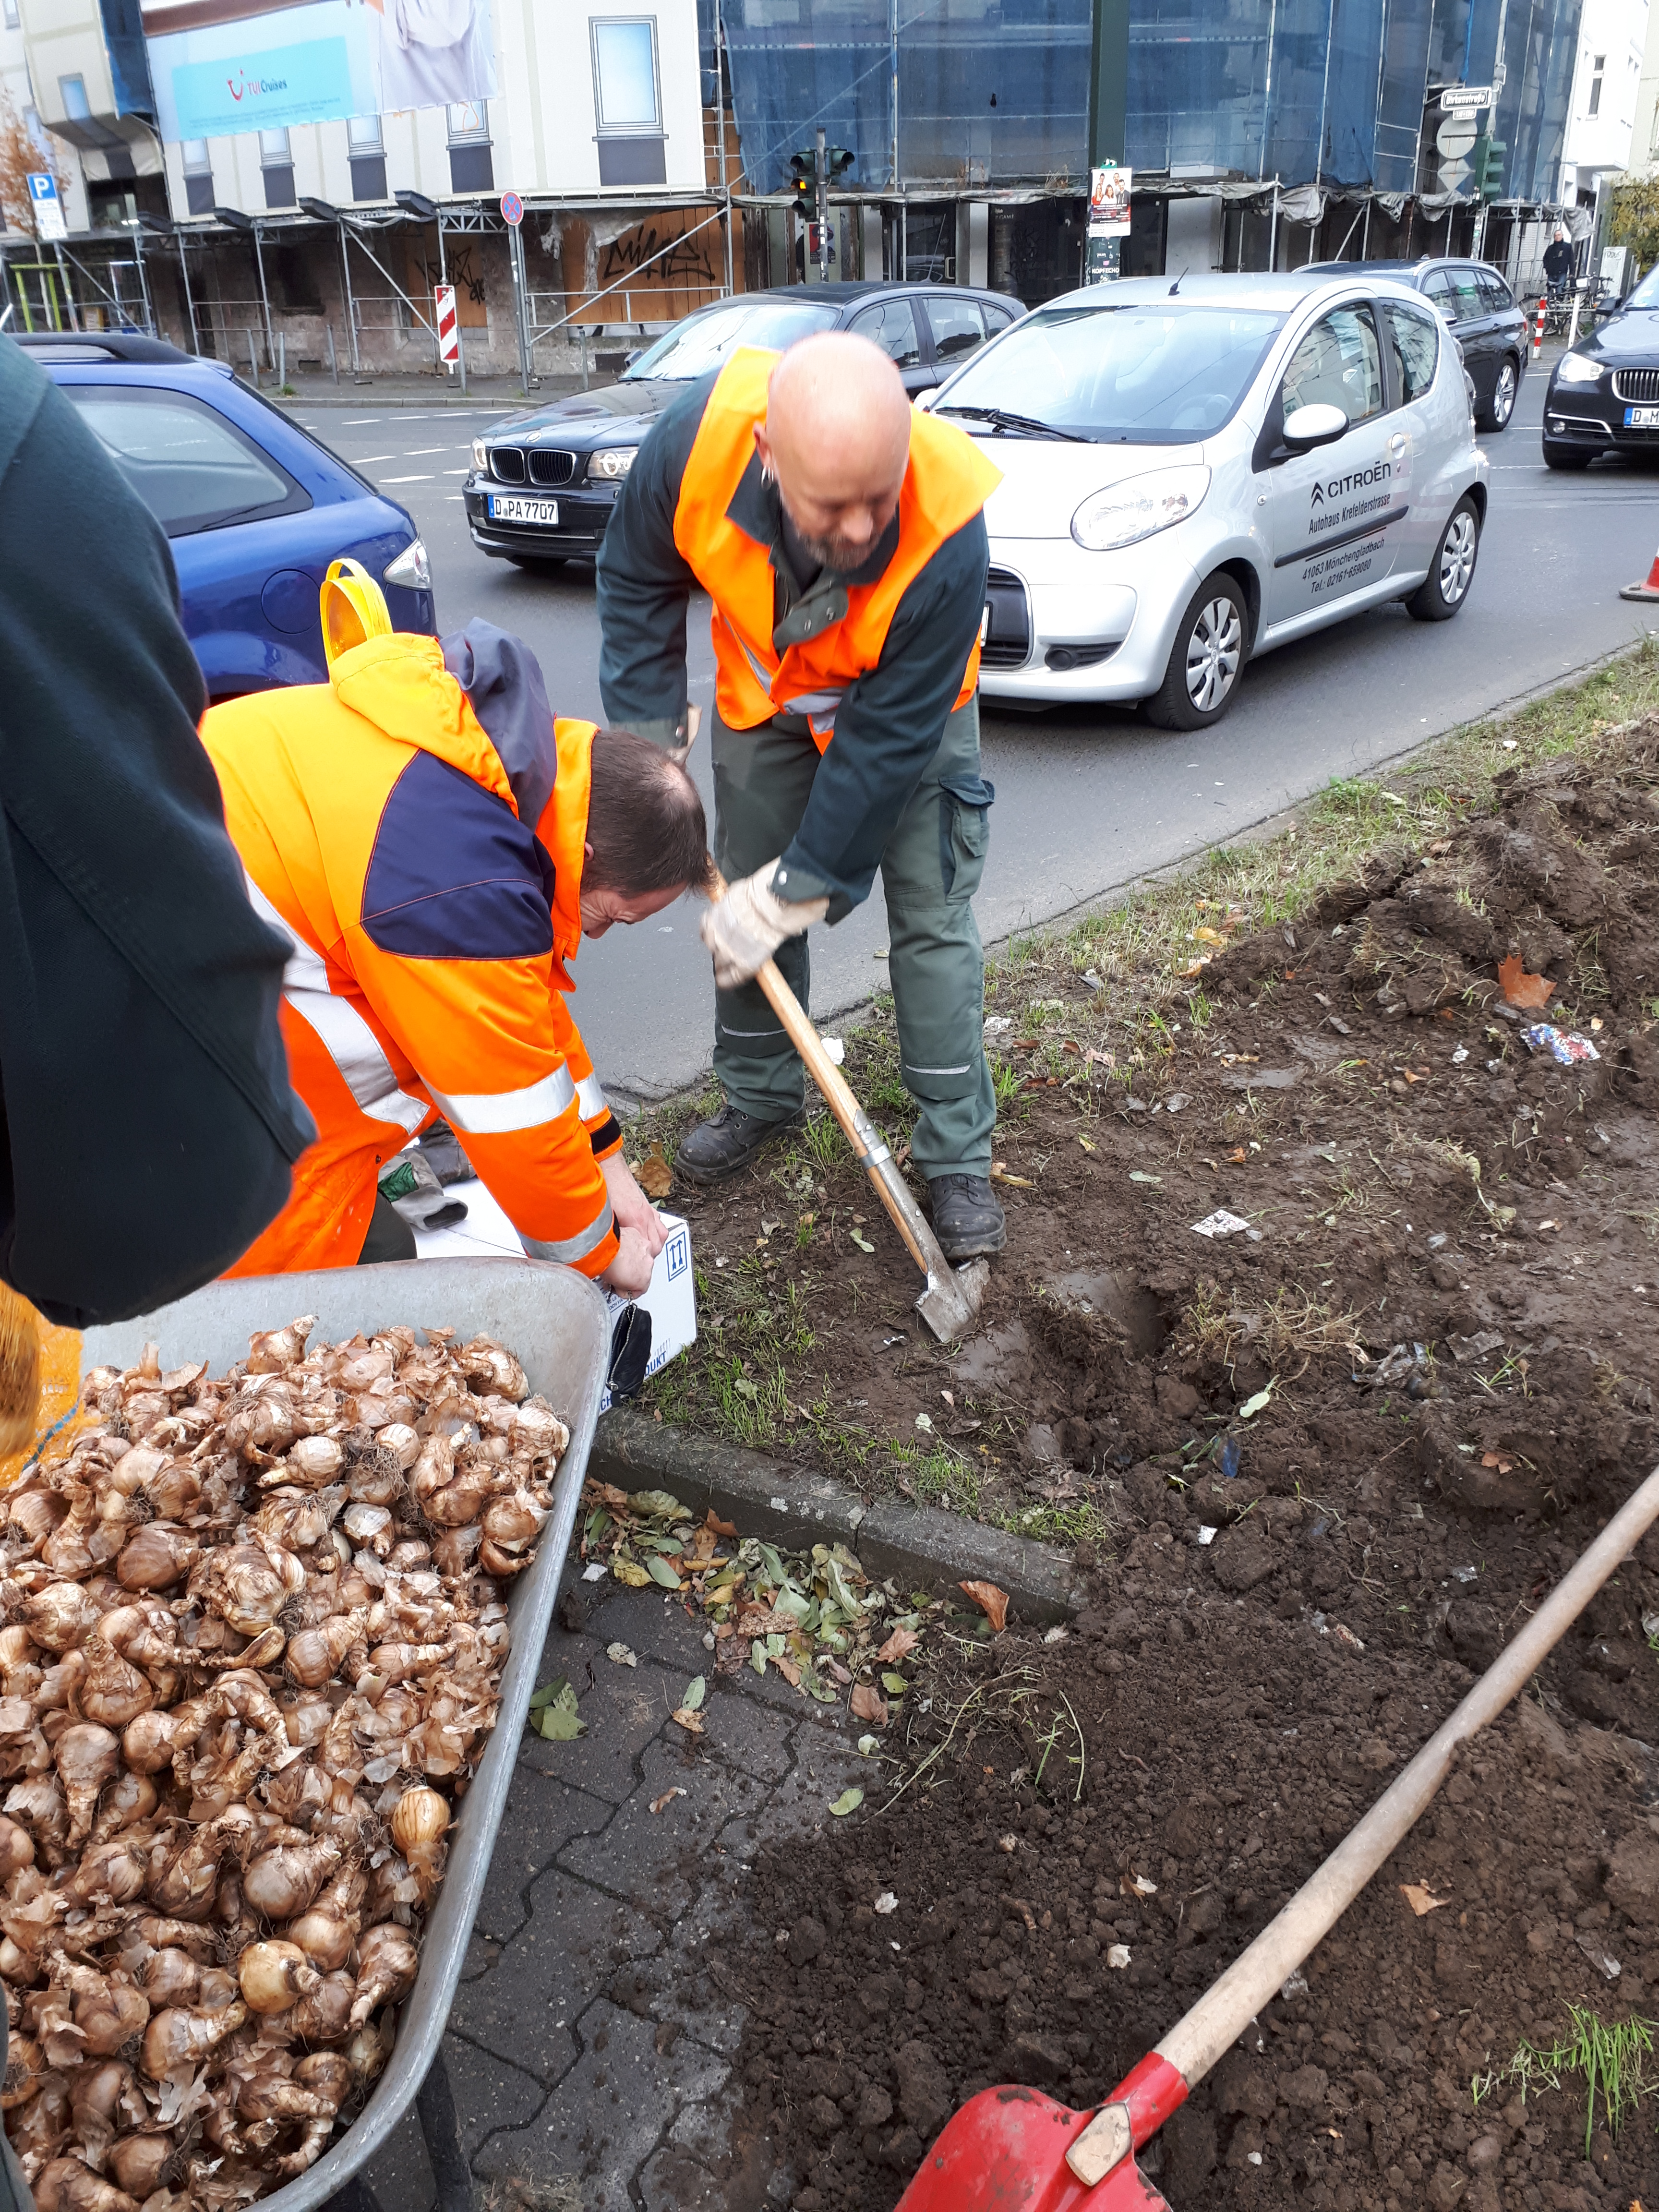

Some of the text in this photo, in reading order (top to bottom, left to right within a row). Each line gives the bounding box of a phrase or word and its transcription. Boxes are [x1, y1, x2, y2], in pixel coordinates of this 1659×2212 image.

[34, 177, 49, 198] P
[1633, 410, 1642, 422] D
[495, 499, 501, 515] D
[1309, 493, 1391, 535] Autohaus Krefelderstrasse
[1302, 537, 1385, 581] 41063 Mönchengladbach
[644, 1350, 666, 1377] DUKT
